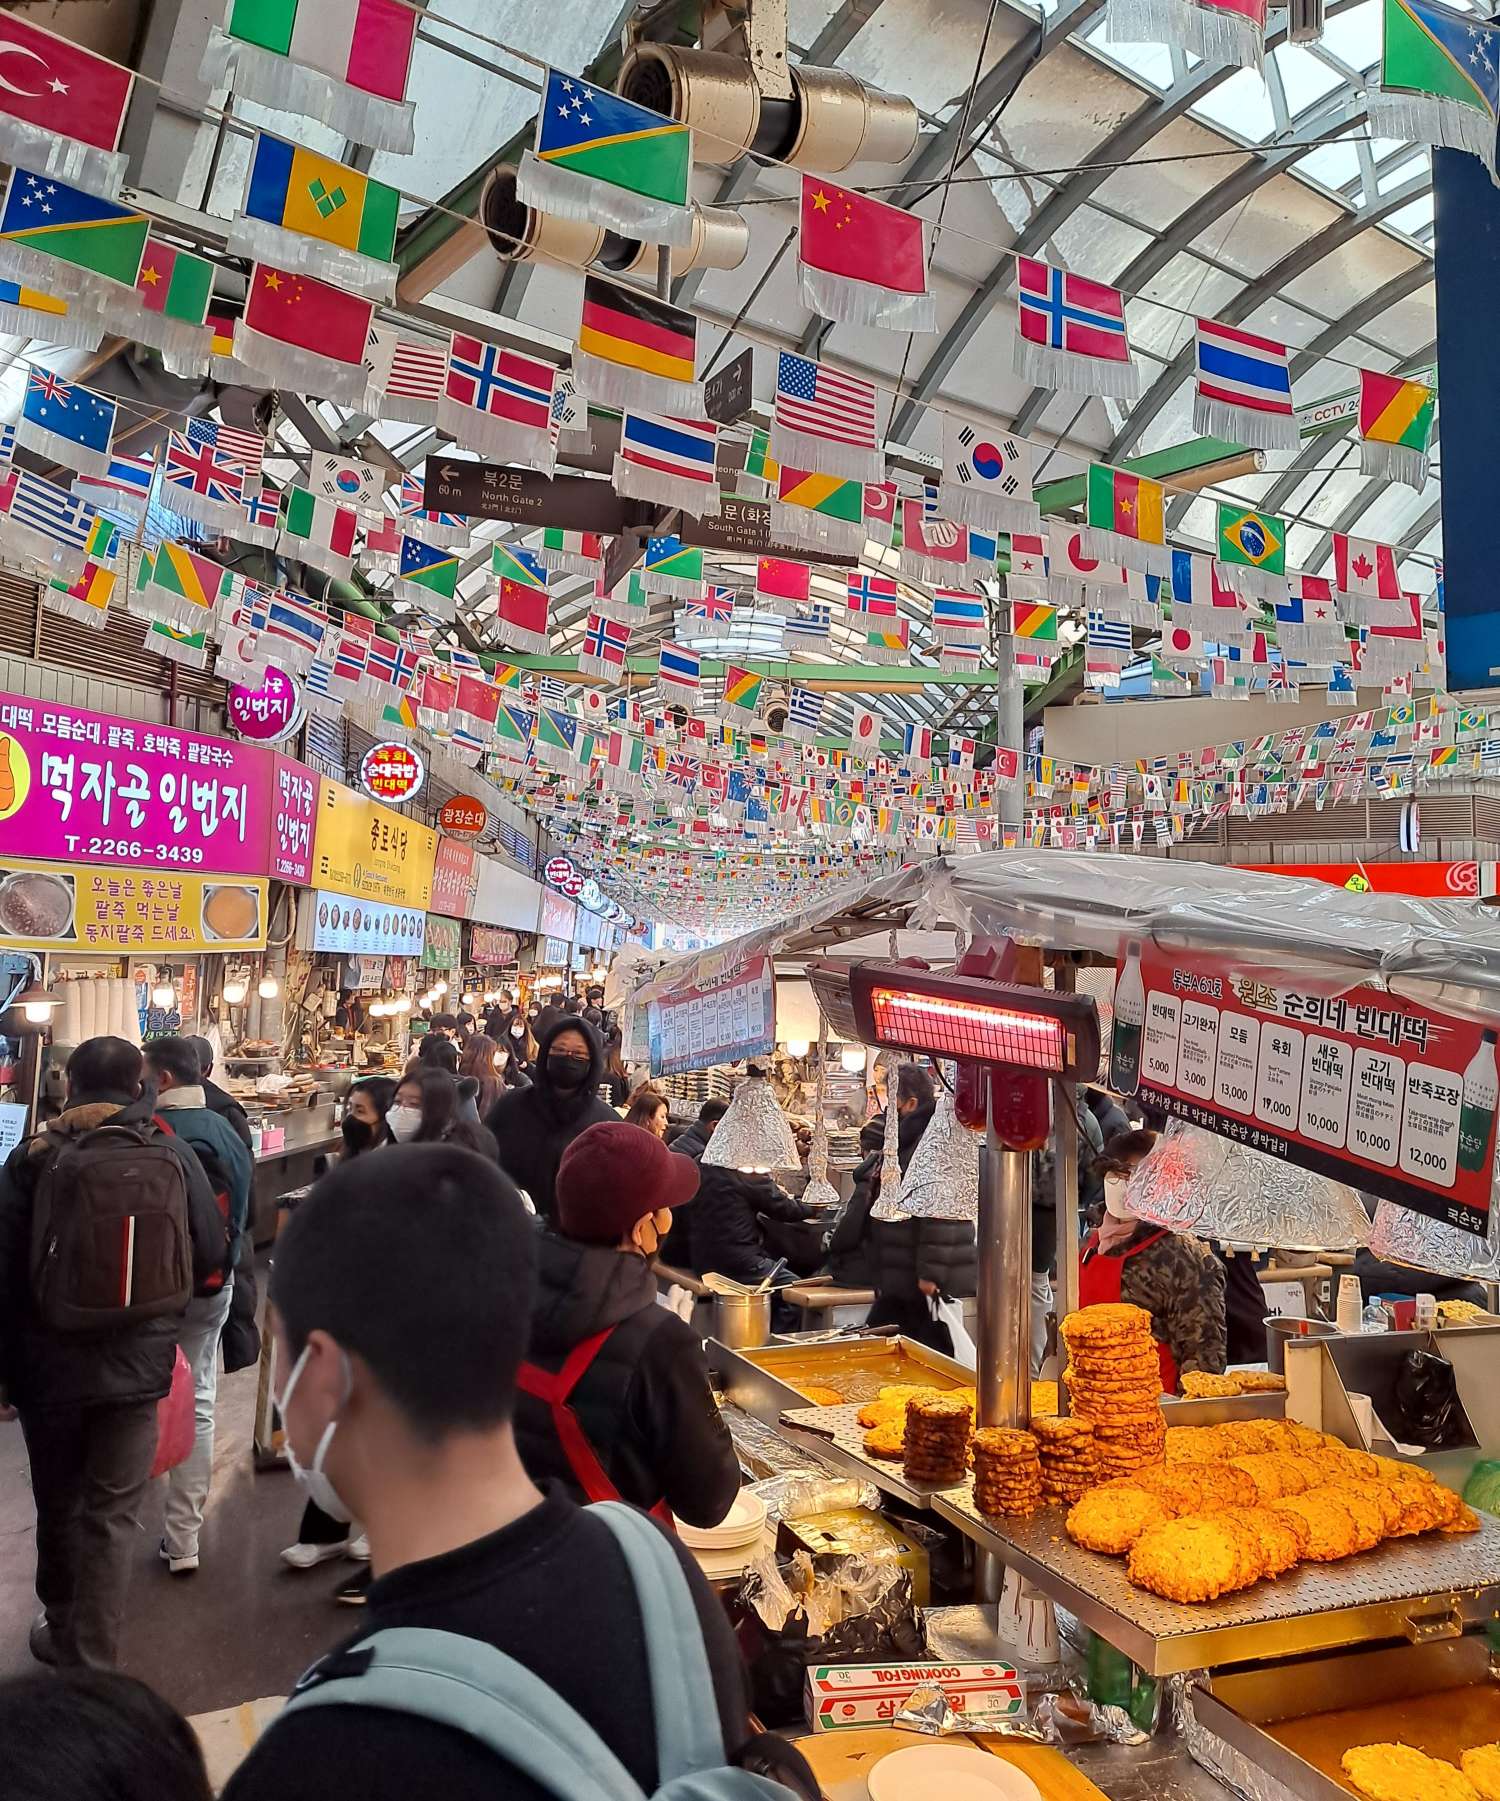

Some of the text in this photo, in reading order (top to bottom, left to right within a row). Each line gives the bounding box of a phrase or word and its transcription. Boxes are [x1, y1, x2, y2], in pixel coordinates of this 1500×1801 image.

[1314, 403, 1346, 421] CCTV
[438, 484, 462, 497] 60 m
[483, 470, 523, 491] 북2문
[481, 490, 543, 507] North Gate 2
[708, 521, 734, 532] South
[736, 525, 757, 536] Gate
[234, 696, 288, 722] 일번지
[187, 742, 234, 768] 팥칼국수
[368, 763, 415, 779] 순대국밥
[279, 767, 314, 817] 먹자골
[372, 778, 409, 792] 빈대떡
[41, 751, 248, 842] 먹자골 일번지
[444, 808, 485, 827] 광장순대
[276, 812, 312, 859] 일번지
[371, 817, 409, 862] 종로식당
[64, 834, 204, 864] T.2266-3439
[91, 876, 183, 900] 오늘은 좋은날
[95, 900, 181, 922] 팥죽 먹는날
[84, 924, 145, 945] 동지팥죽
[149, 1008, 181, 1031] 장수
[1152, 1003, 1176, 1022] 빈대떡
[1238, 978, 1428, 1053] 원조 순희네 빈대떡
[1183, 1013, 1217, 1035] 고기완자
[1229, 1026, 1249, 1044] 모듬
[1271, 1038, 1292, 1057] 육회
[1317, 1043, 1339, 1062] 새우
[1149, 1058, 1169, 1075] 5,000
[1311, 1056, 1344, 1080] 빈대떡
[1366, 1057, 1391, 1078] 고기
[1184, 1070, 1207, 1087] 3,000
[1360, 1071, 1395, 1096] 빈대떡
[1221, 1083, 1249, 1102] 13,000
[1405, 1077, 1460, 1106] 반죽포장
[1140, 1088, 1171, 1111] 광장시장
[1173, 1101, 1189, 1117] 대표
[1221, 1119, 1249, 1141] 국순당
[1250, 1131, 1288, 1157] 생막걸리
[1306, 1112, 1339, 1134] 10,000
[1355, 1129, 1391, 1152] 10,000
[1409, 1147, 1447, 1171] 12,000
[1447, 1206, 1483, 1232] 국순당
